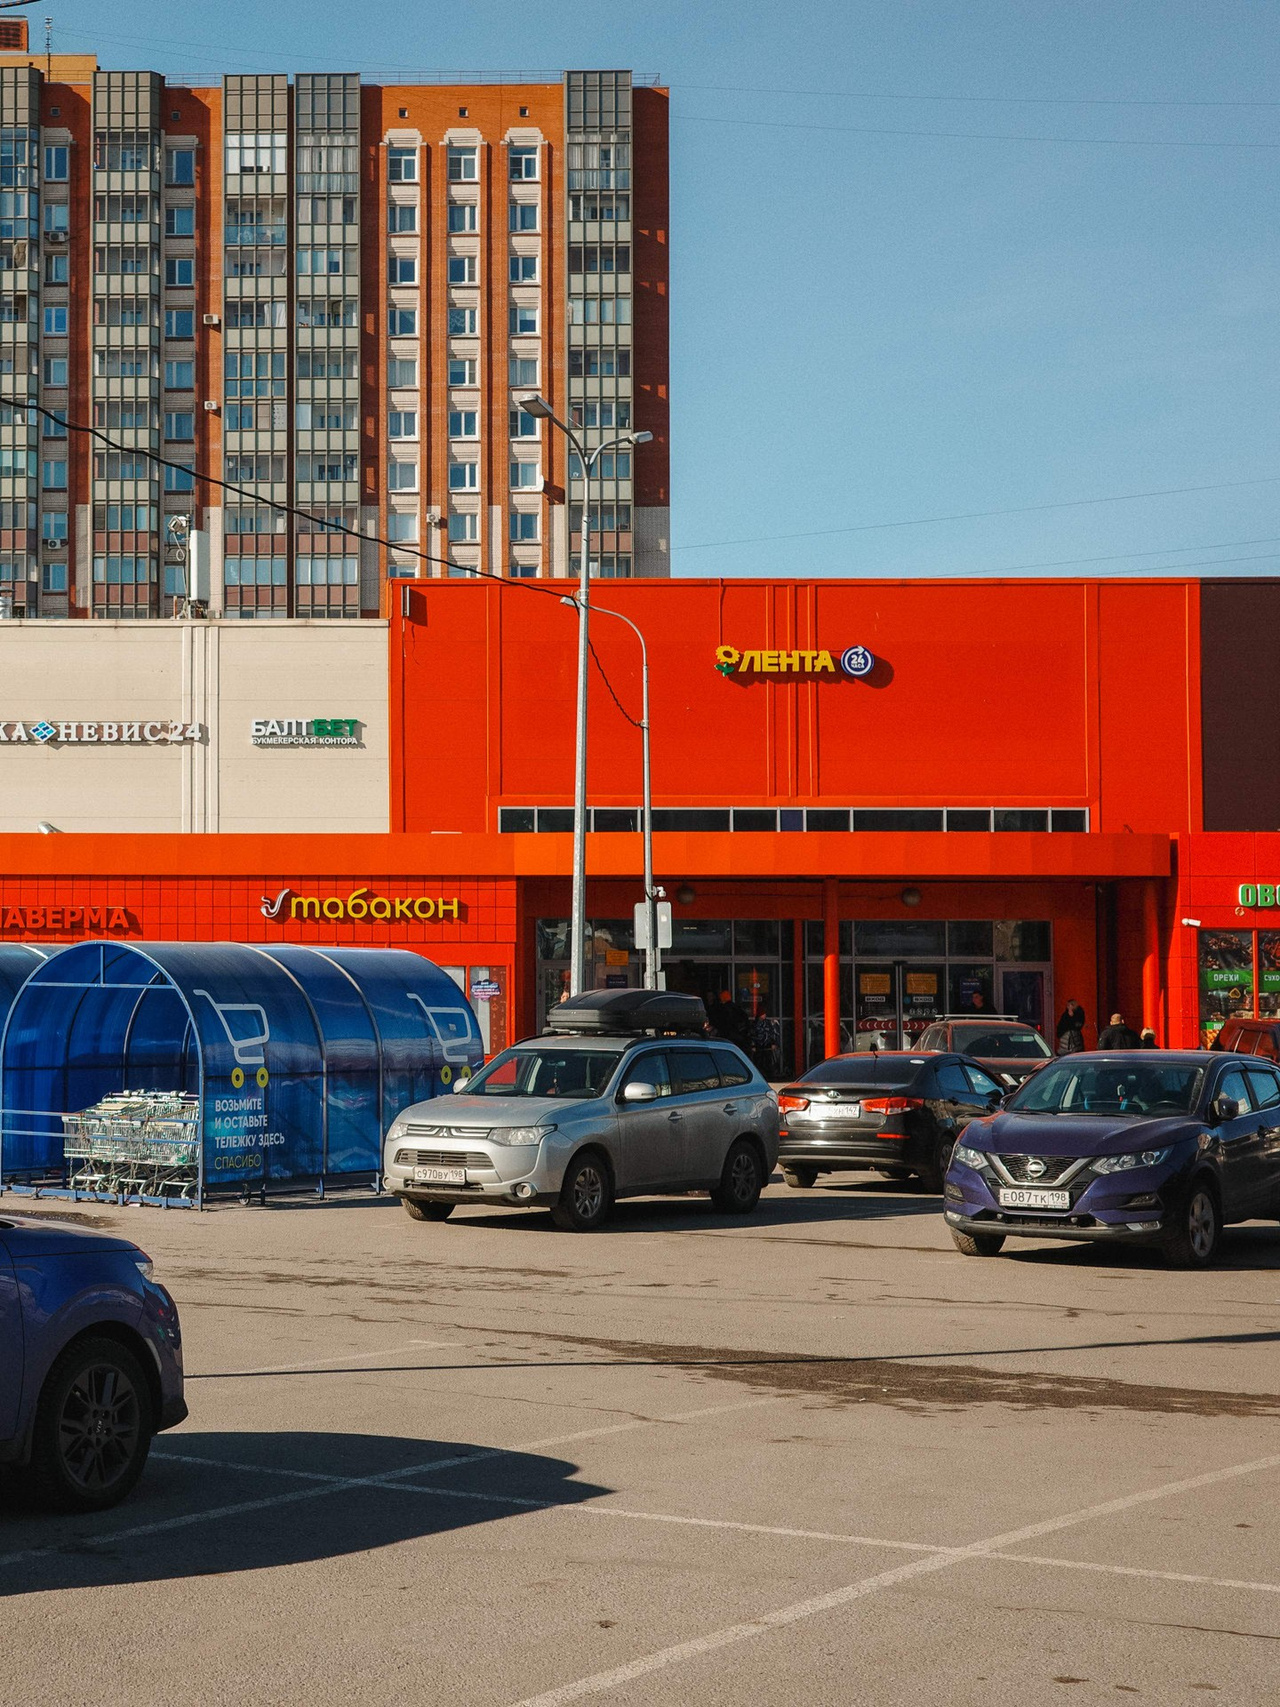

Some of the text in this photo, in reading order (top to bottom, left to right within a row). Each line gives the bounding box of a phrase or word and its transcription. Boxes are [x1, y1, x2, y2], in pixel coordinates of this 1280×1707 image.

[738, 650, 835, 672] ЛЕНТА
[851, 655, 865, 664] 24
[57, 722, 161, 742] НЕВИС
[168, 722, 202, 741] 24
[251, 719, 358, 736] БАЛТБЕТ
[251, 737, 358, 745] БУКМЕКЕРСКАЯ КОНТОРА
[1239, 884, 1280, 907] ОВ
[291, 888, 459, 919] табакон
[1213, 973, 1239, 982] ОРЕХИ
[1264, 974, 1280, 982] СУХО
[215, 1098, 262, 1112] ВОЗЬМИТЕ
[214, 1114, 268, 1129] И ОСТАВЬТЕ
[215, 1133, 285, 1149] ТЕЛЕЖКУ ЗДЕСЬ
[214, 1153, 262, 1170] СПАСИБО
[450, 1169, 463, 1178] 198
[1003, 1191, 1066, 1204] Е087ТК 198
